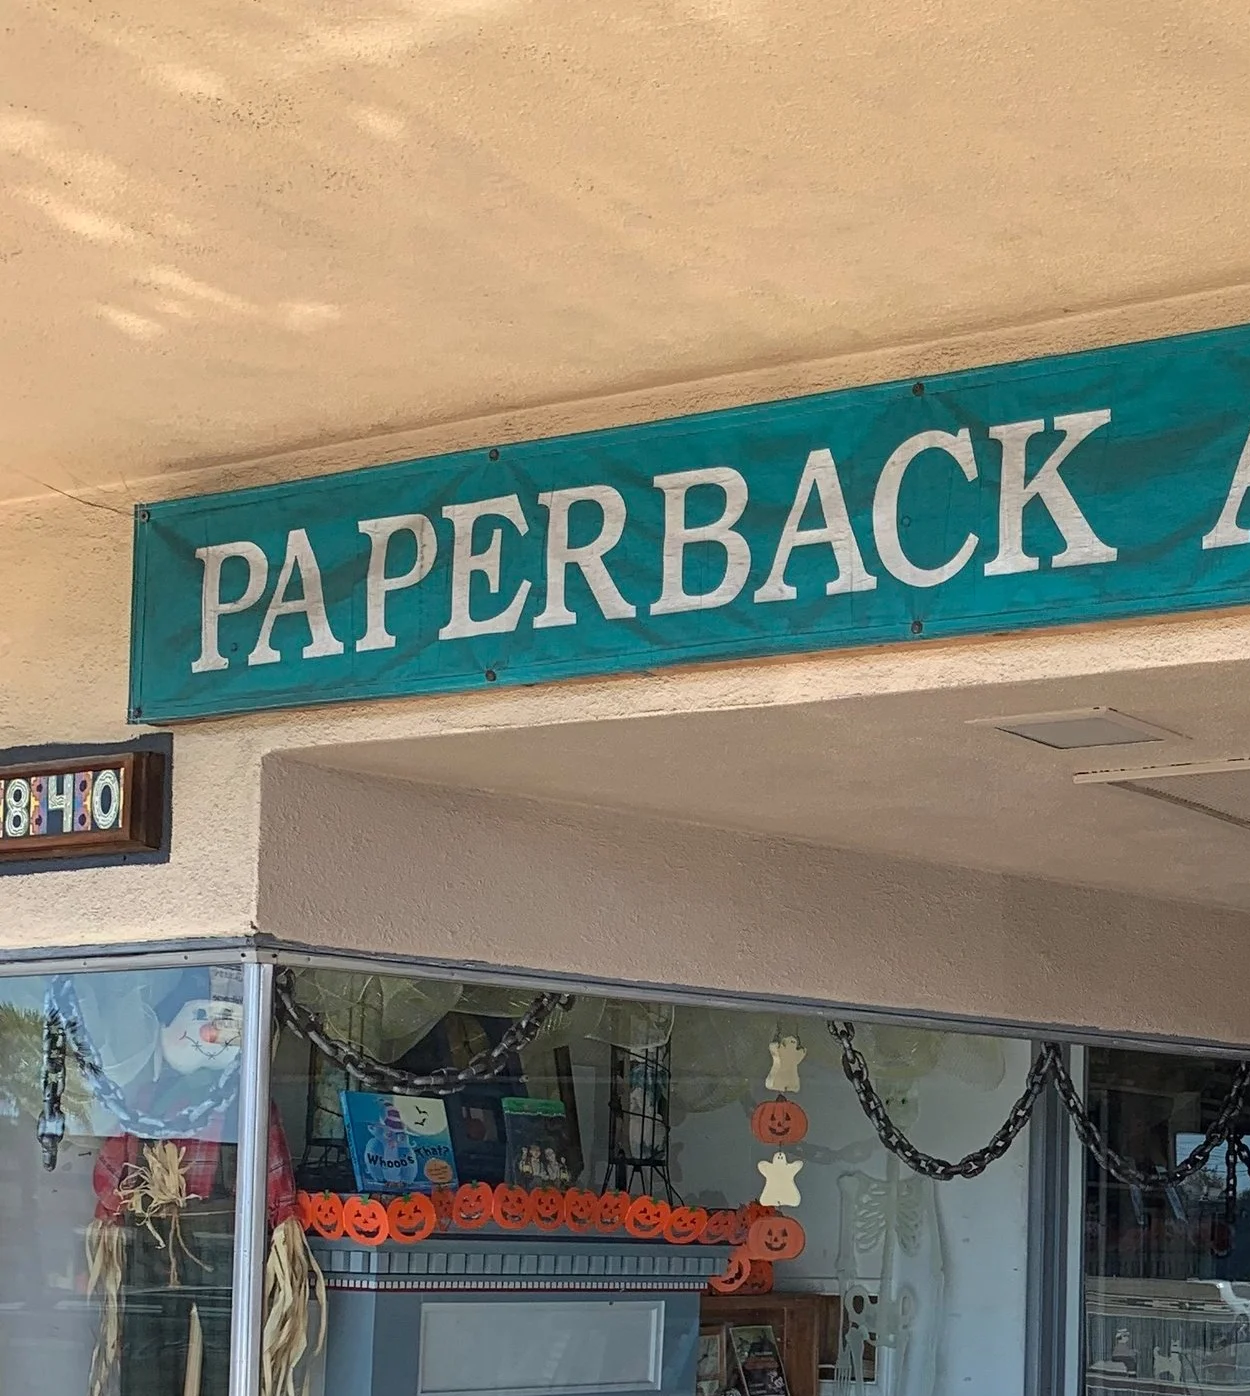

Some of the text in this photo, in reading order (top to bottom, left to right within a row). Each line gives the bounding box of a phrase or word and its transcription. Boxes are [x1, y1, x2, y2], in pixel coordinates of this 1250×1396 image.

[190, 408, 1118, 674] PAPERBACK
[367, 1146, 450, 1168] Whooo's That?
